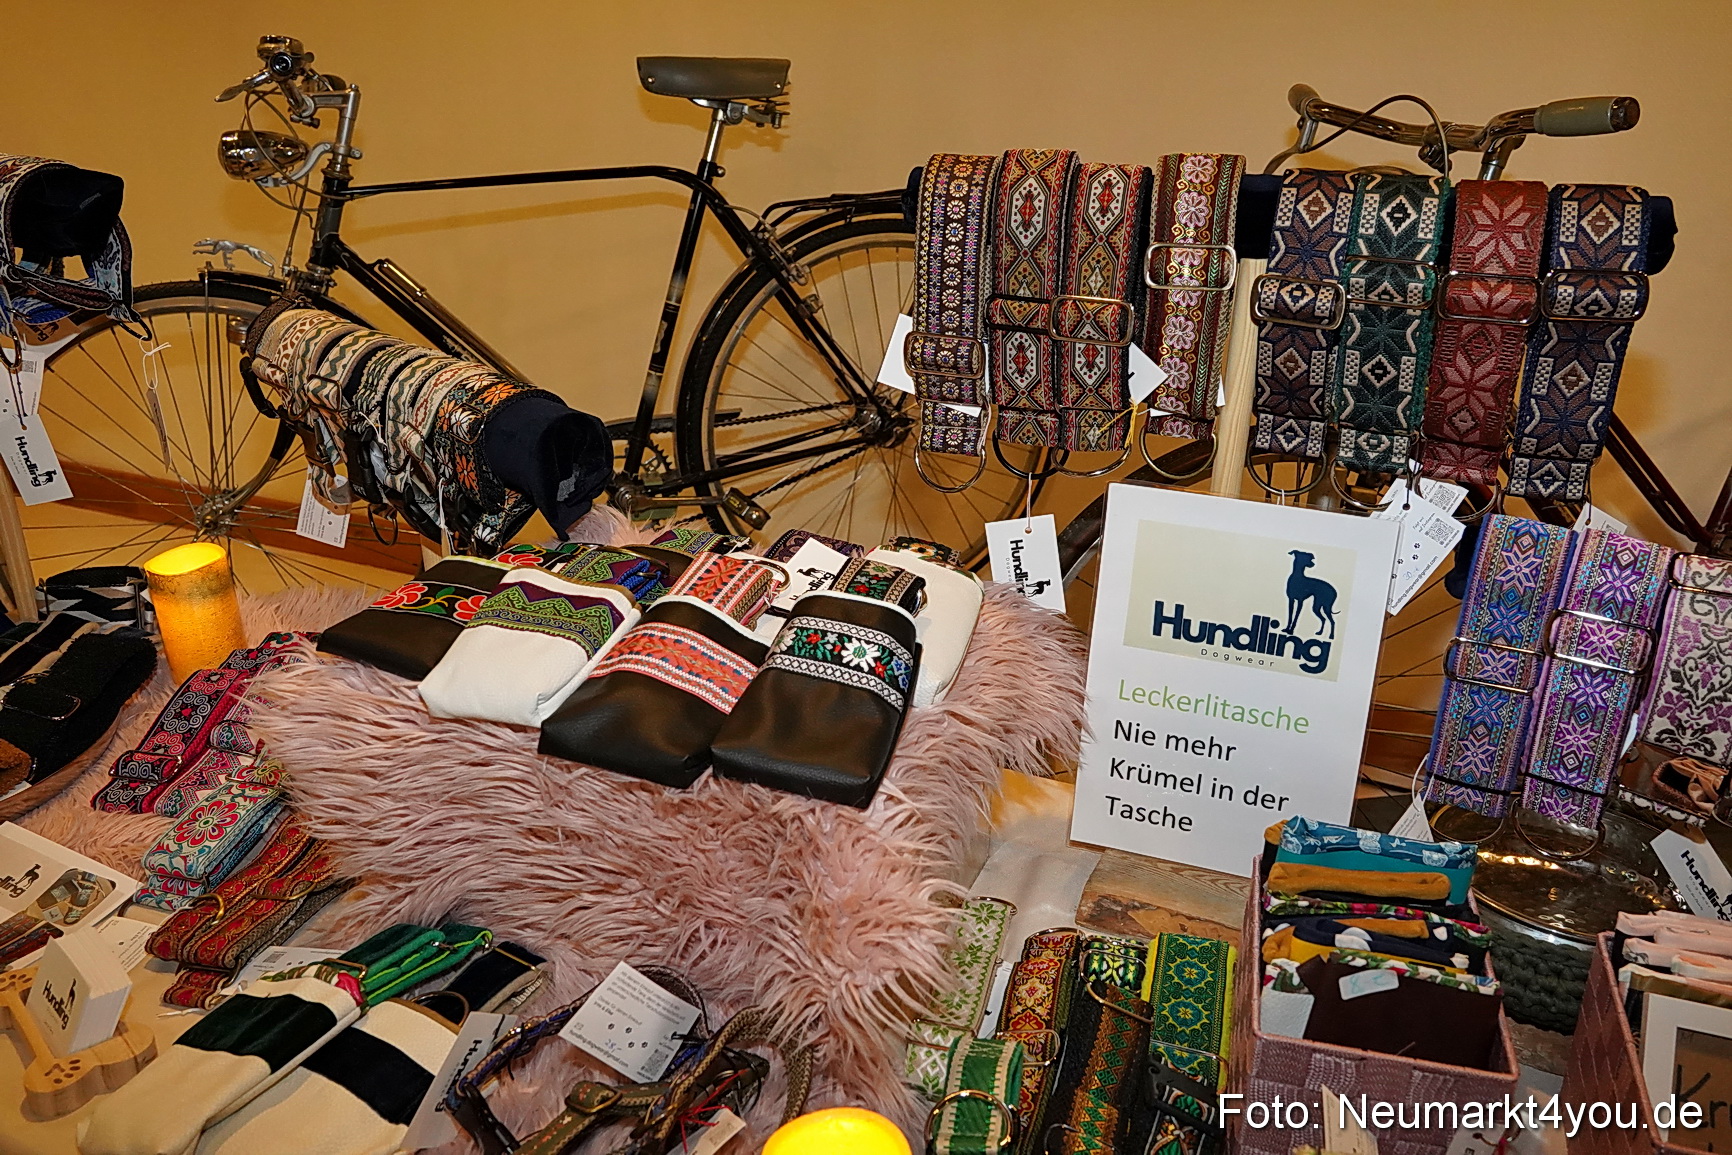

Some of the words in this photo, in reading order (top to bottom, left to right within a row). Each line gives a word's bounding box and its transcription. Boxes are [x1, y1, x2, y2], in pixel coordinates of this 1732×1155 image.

[15, 435, 43, 488] Hundling
[1152, 600, 1331, 674] Hundling
[1200, 648, 1275, 668] Dogwear
[1118, 679, 1310, 734] Leckerlitasche
[1113, 719, 1156, 746] Nie
[1165, 735, 1237, 762] mehr
[1109, 757, 1203, 795] Krümel
[1210, 777, 1234, 802] in
[1242, 785, 1290, 812] der
[1104, 796, 1193, 832] Tasche
